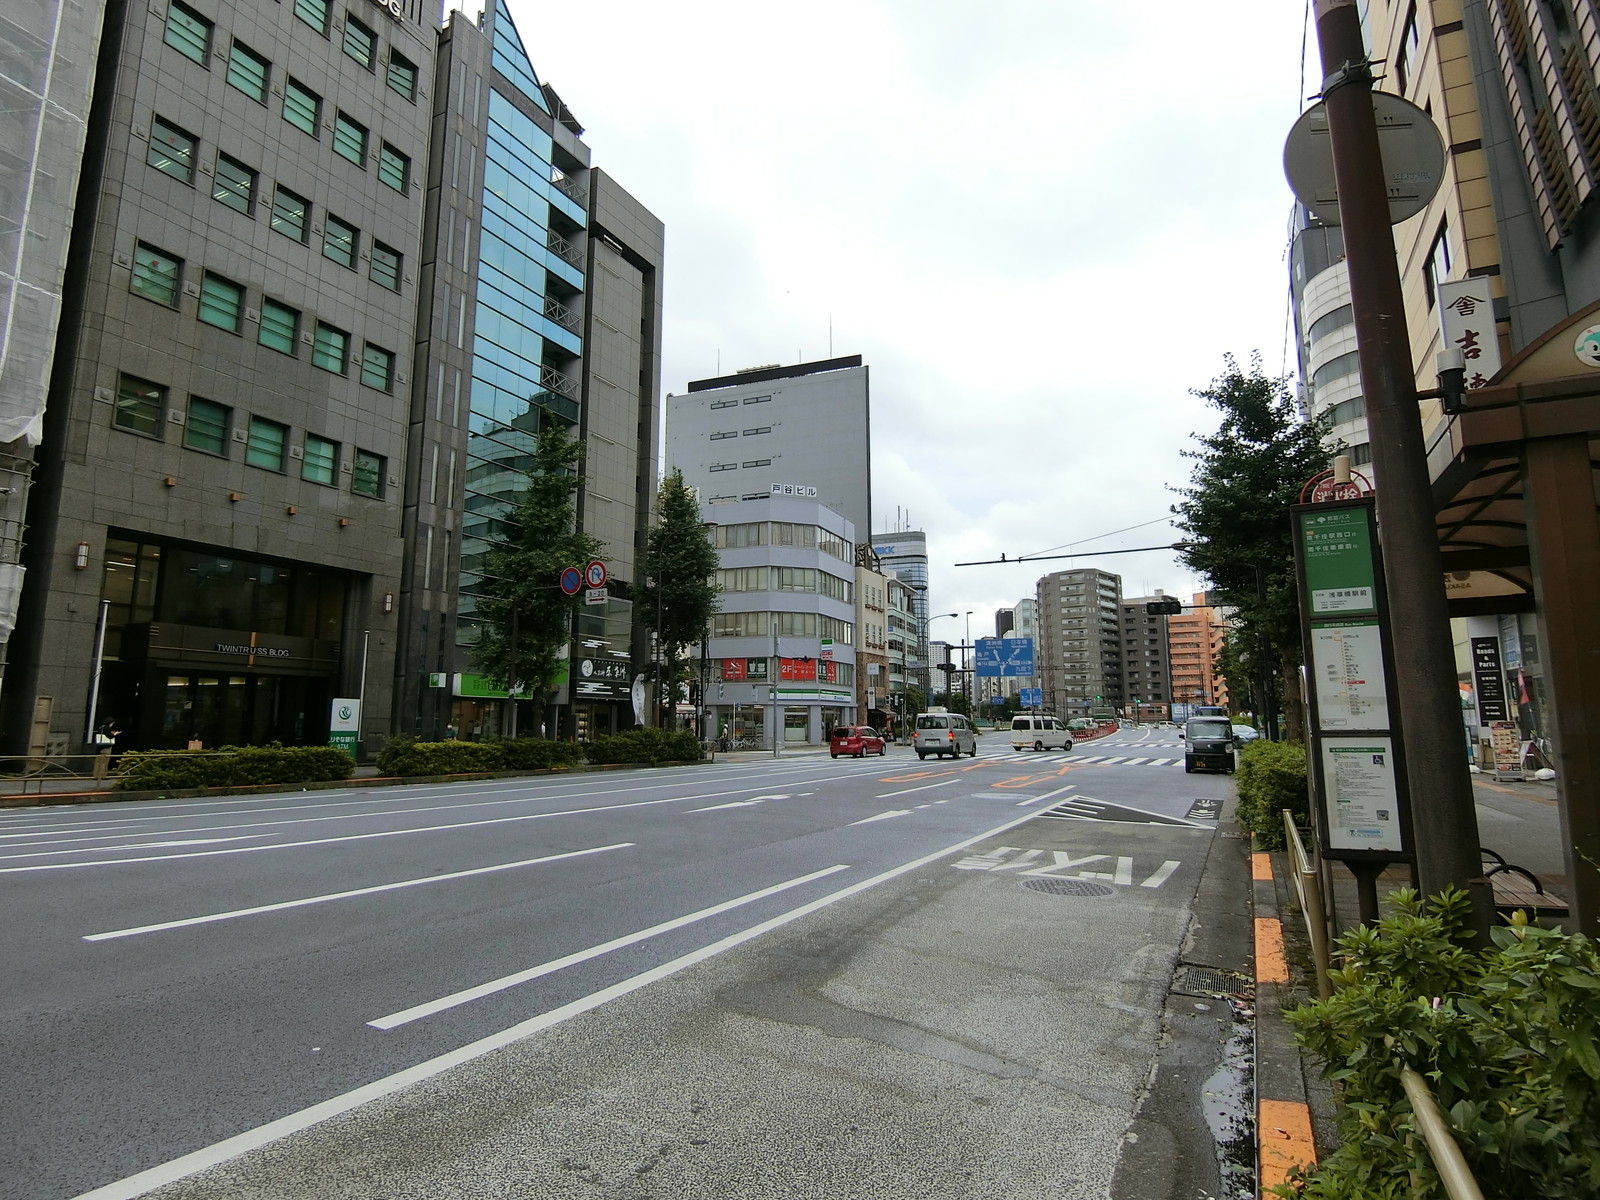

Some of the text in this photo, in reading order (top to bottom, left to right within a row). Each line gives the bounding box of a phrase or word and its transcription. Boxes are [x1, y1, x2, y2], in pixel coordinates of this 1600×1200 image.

[772, 483, 816, 497] 戸谷ビル
[1328, 589, 1367, 598] 浅草橋駅前
[269, 649, 289, 657] BLDG
[782, 665, 792, 673] 2F
